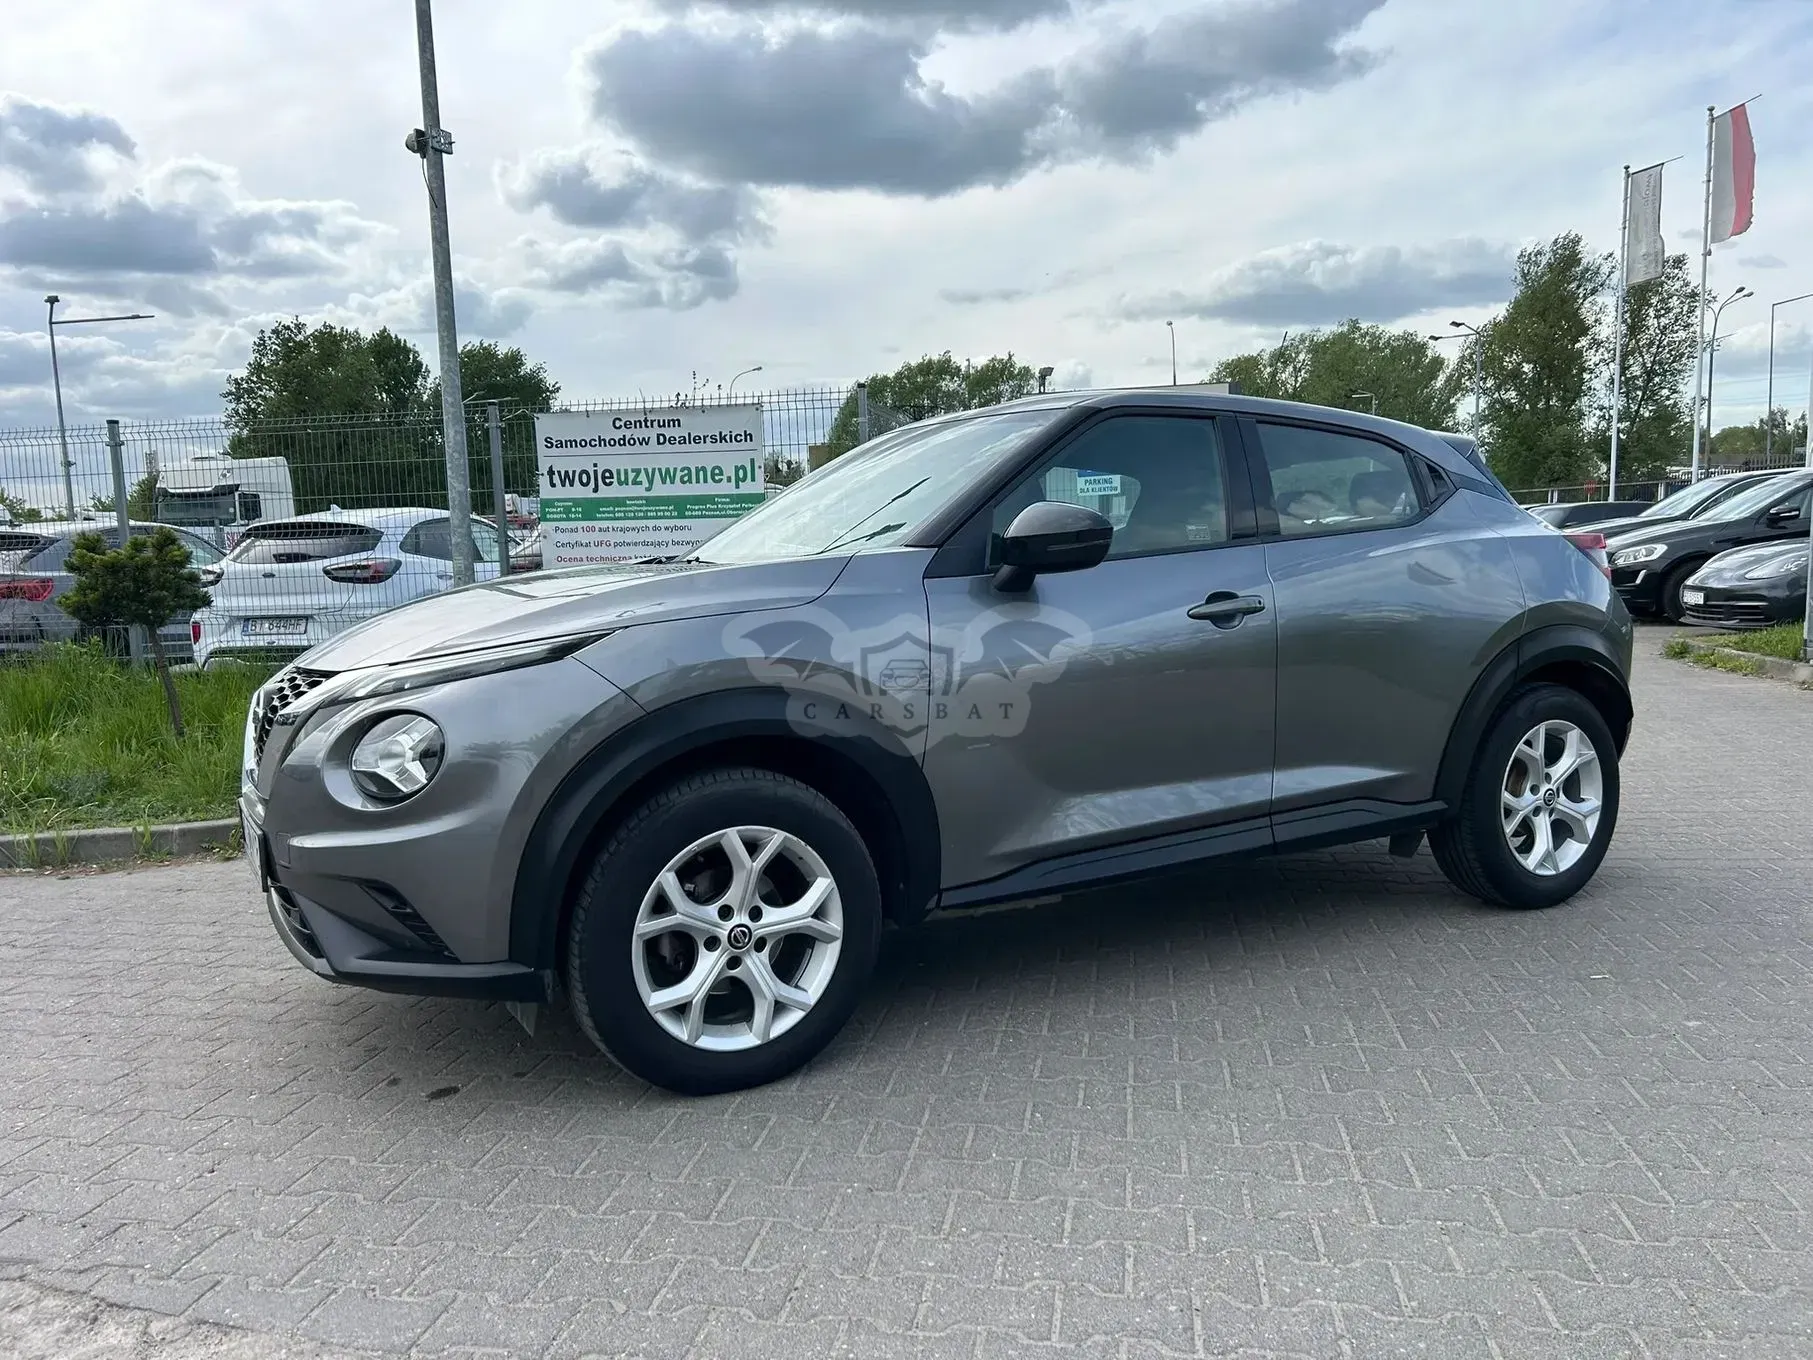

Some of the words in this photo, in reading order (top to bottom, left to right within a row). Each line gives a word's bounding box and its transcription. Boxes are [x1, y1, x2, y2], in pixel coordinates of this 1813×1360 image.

[612, 417, 681, 430] Centrum
[544, 434, 651, 449] Samochodów
[656, 430, 753, 446] Dealerskich
[547, 458, 756, 494] twojeuzywane.pl
[1084, 477, 1113, 486] PARKING
[554, 525, 579, 534] Ponad
[581, 525, 596, 533] 100
[611, 524, 650, 534] krajowych
[652, 524, 662, 532] do
[664, 523, 692, 533] wyboru
[555, 540, 592, 549] Certyfikat
[593, 539, 612, 548] UFG
[613, 538, 669, 549] potwierdzający
[556, 555, 584, 563] Ocena
[586, 554, 633, 563] techniczna
